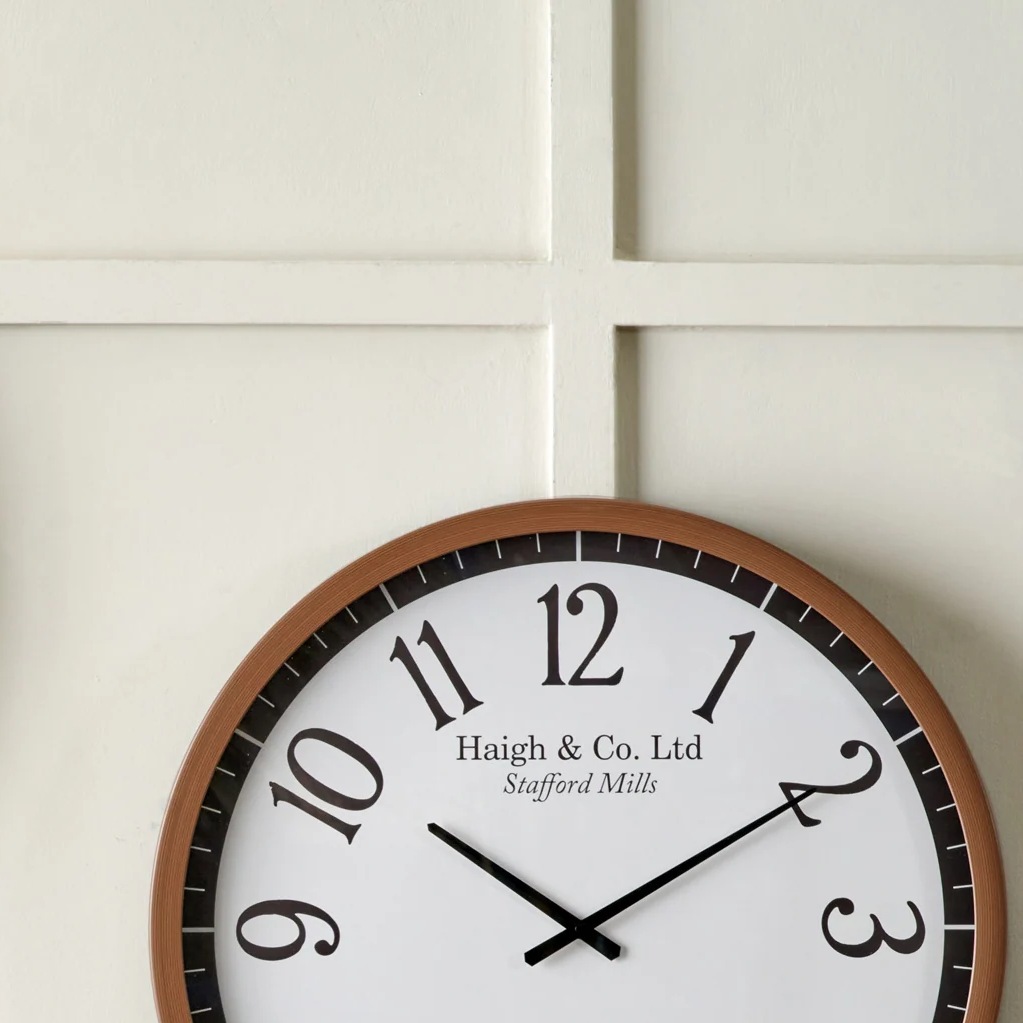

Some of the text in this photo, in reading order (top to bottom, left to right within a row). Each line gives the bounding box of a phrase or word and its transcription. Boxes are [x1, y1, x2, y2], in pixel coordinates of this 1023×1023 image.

[388, 618, 484, 732] 11
[536, 582, 624, 686] 12
[691, 630, 756, 725] 1
[268, 726, 384, 845] 10
[455, 734, 703, 767] Haigh & Co. Ltd
[502, 772, 658, 802] Stafford Mills
[777, 739, 883, 828] 2
[235, 899, 341, 962] 9
[821, 897, 926, 959] 3
